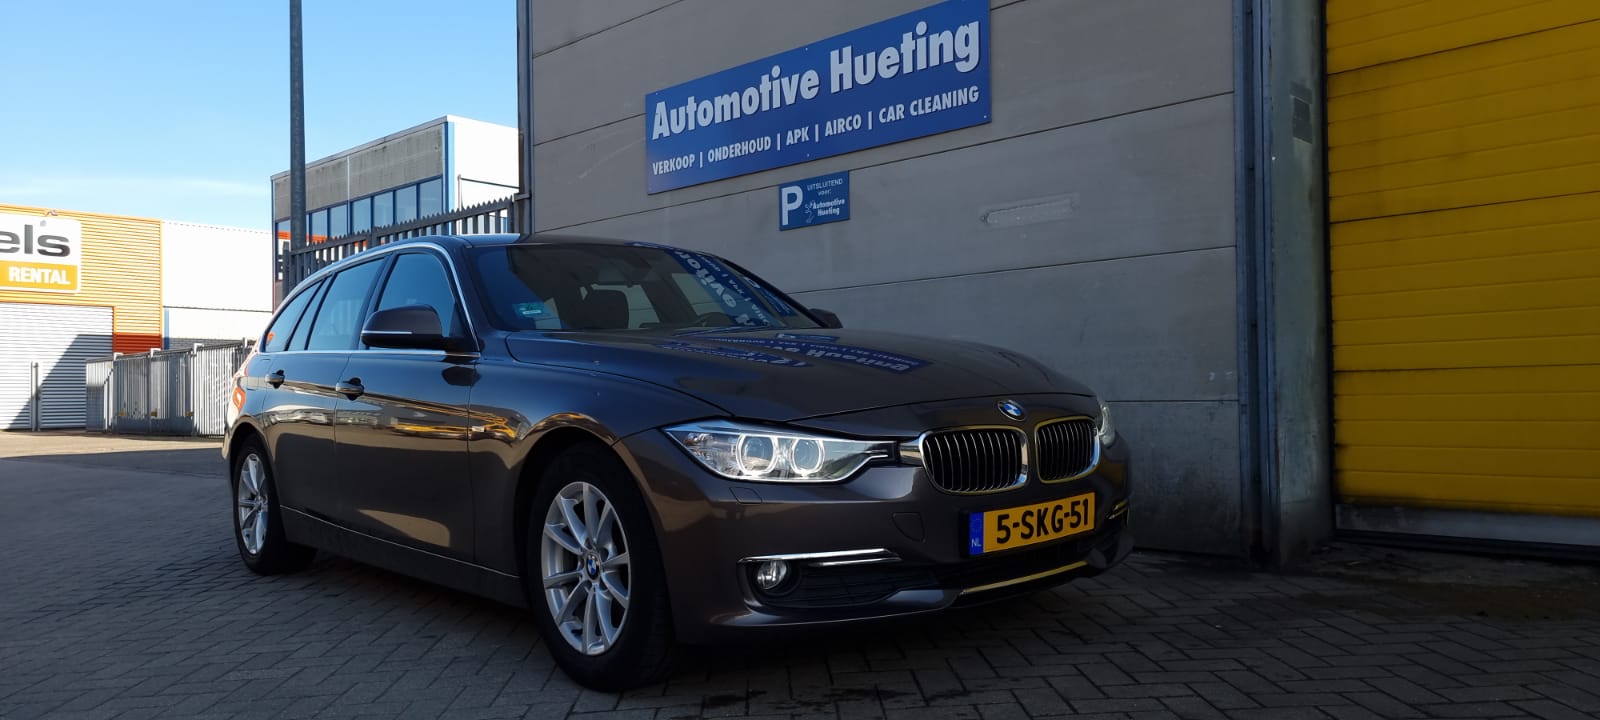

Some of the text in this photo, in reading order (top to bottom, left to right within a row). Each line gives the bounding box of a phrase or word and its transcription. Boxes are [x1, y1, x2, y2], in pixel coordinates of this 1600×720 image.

[652, 21, 979, 140] Automotive Hueting
[652, 154, 695, 175] VERKOOP
[708, 136, 771, 163] ONDERHOUD
[786, 126, 810, 146] APK
[825, 114, 862, 137] AIRCO
[879, 103, 905, 123] CAR
[910, 85, 979, 116] CLEANING
[807, 178, 843, 191] UITSLUITEND
[781, 185, 803, 226] P
[812, 197, 845, 210] Automotive
[817, 206, 840, 217] Hueting
[8, 266, 71, 285] RENTAL
[996, 498, 1089, 545] 5-SKG-51
[971, 537, 982, 548] NL
